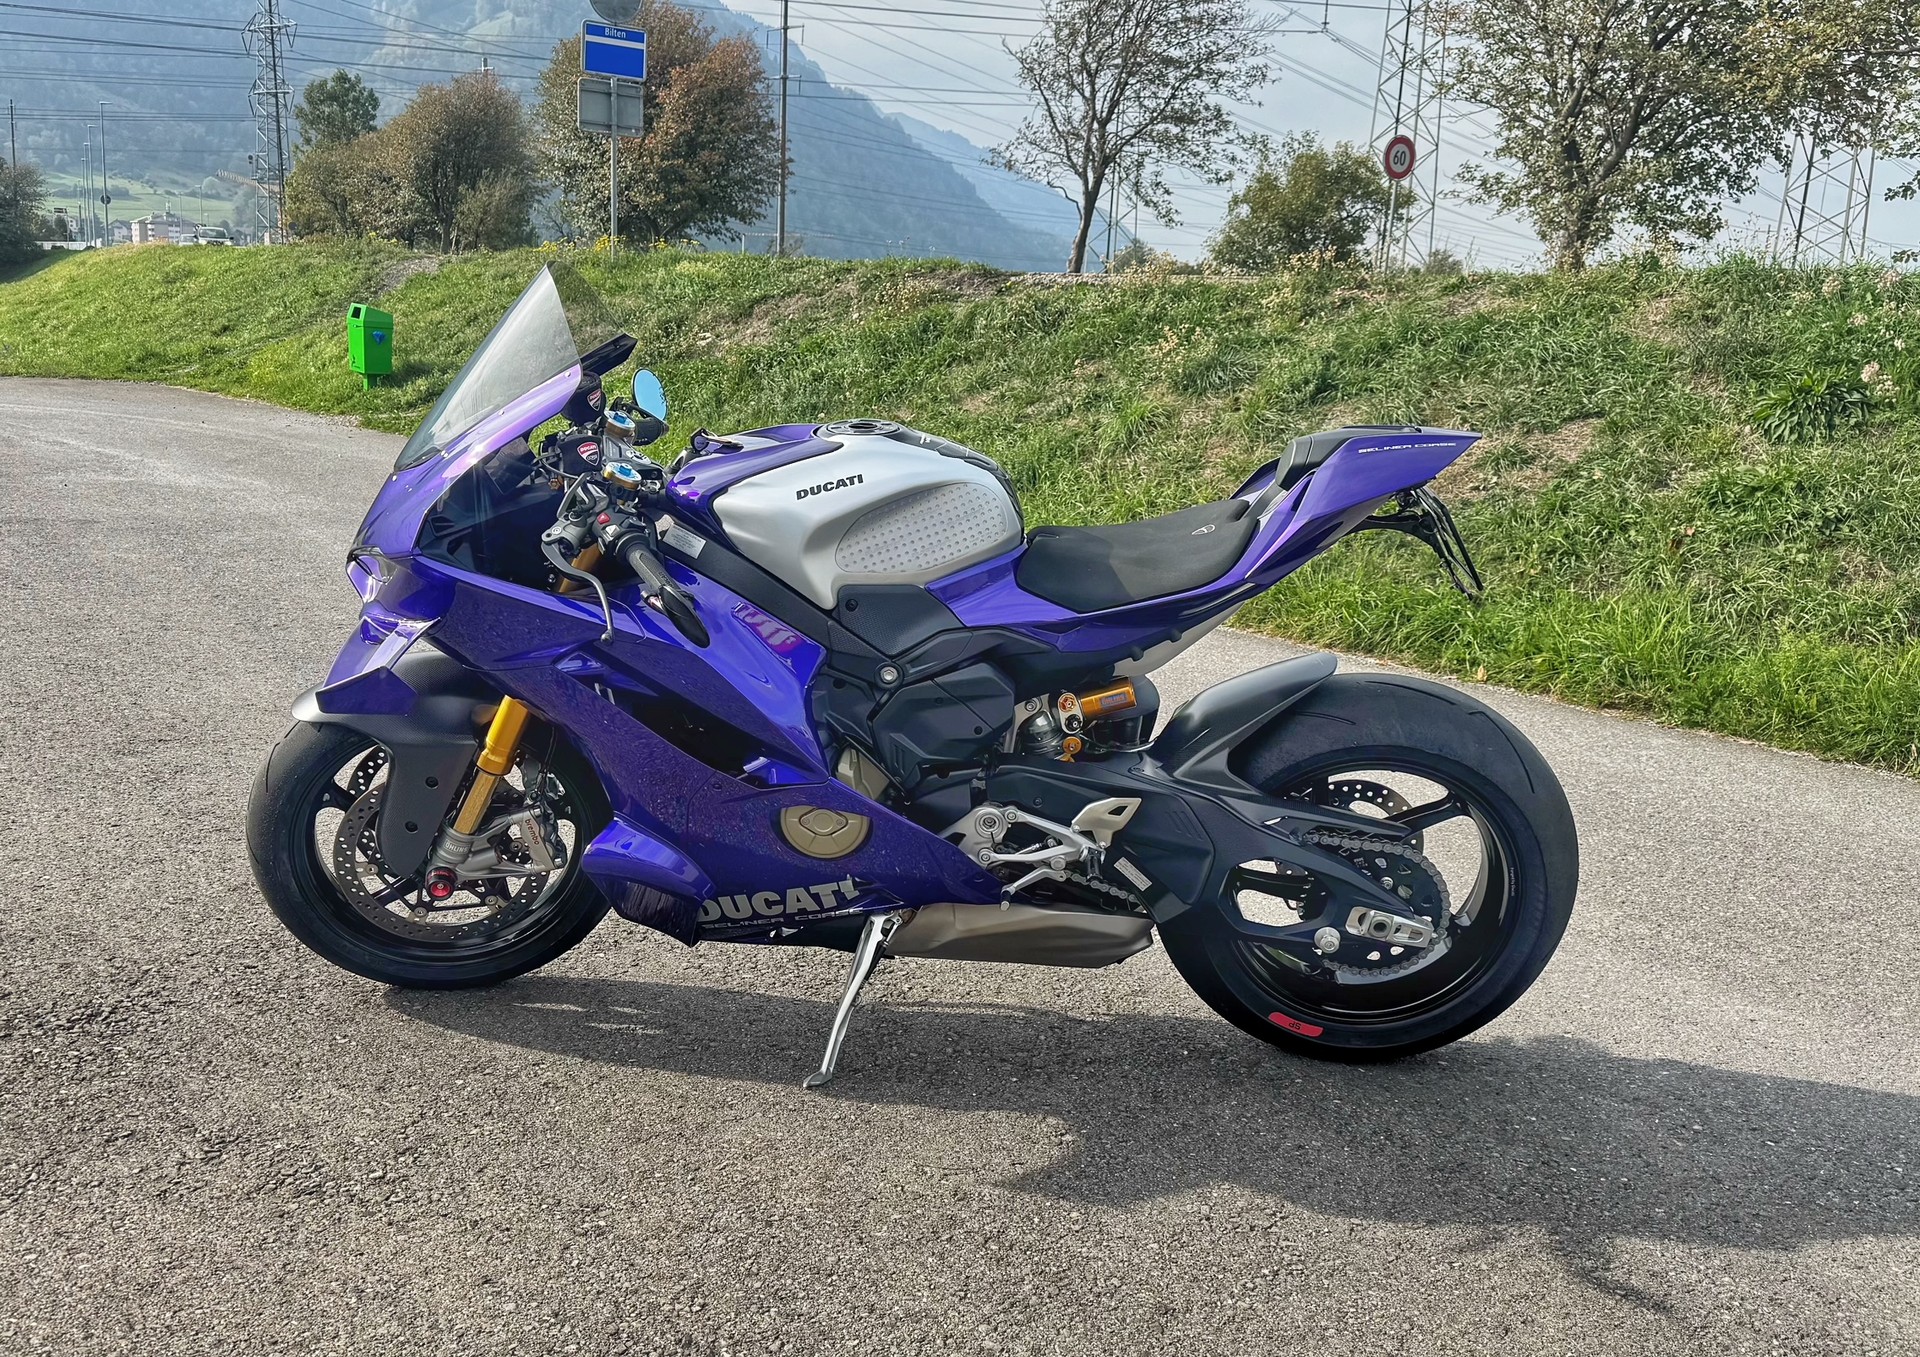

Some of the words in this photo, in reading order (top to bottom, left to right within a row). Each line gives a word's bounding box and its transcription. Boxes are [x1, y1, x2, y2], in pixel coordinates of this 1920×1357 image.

[604, 27, 626, 39] Bilten
[1393, 150, 1406, 166] 60
[796, 474, 864, 500] DUCATI
[525, 818, 540, 845] brembo
